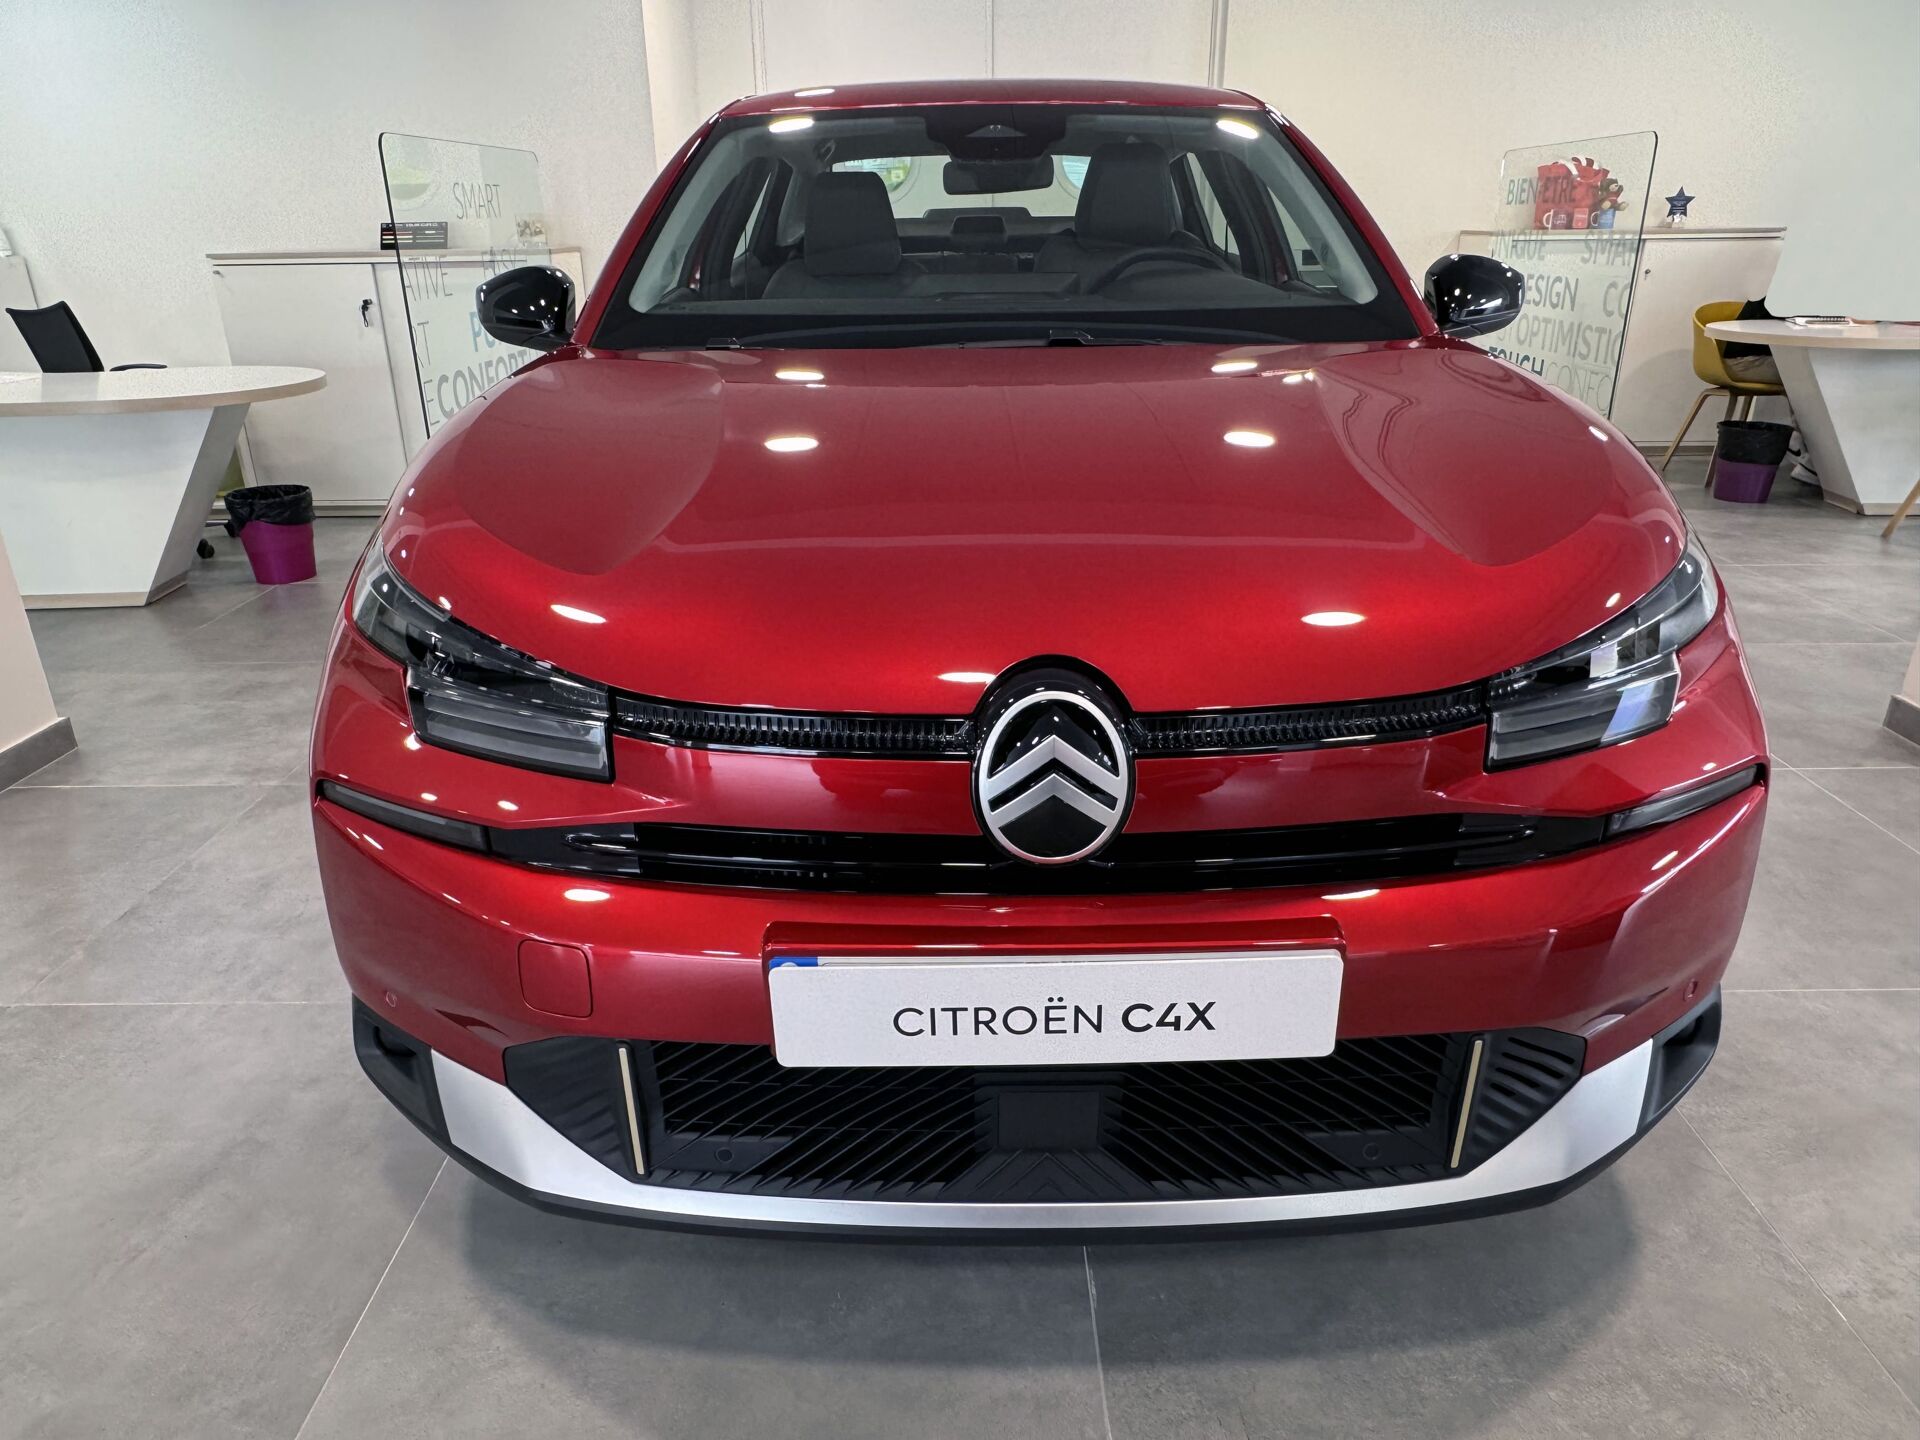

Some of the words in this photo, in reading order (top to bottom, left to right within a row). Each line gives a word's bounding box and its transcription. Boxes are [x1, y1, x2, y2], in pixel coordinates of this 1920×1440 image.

[453, 182, 501, 219] SMART
[893, 997, 1103, 1036] CITROËN
[1121, 1001, 1217, 1033] C4X
